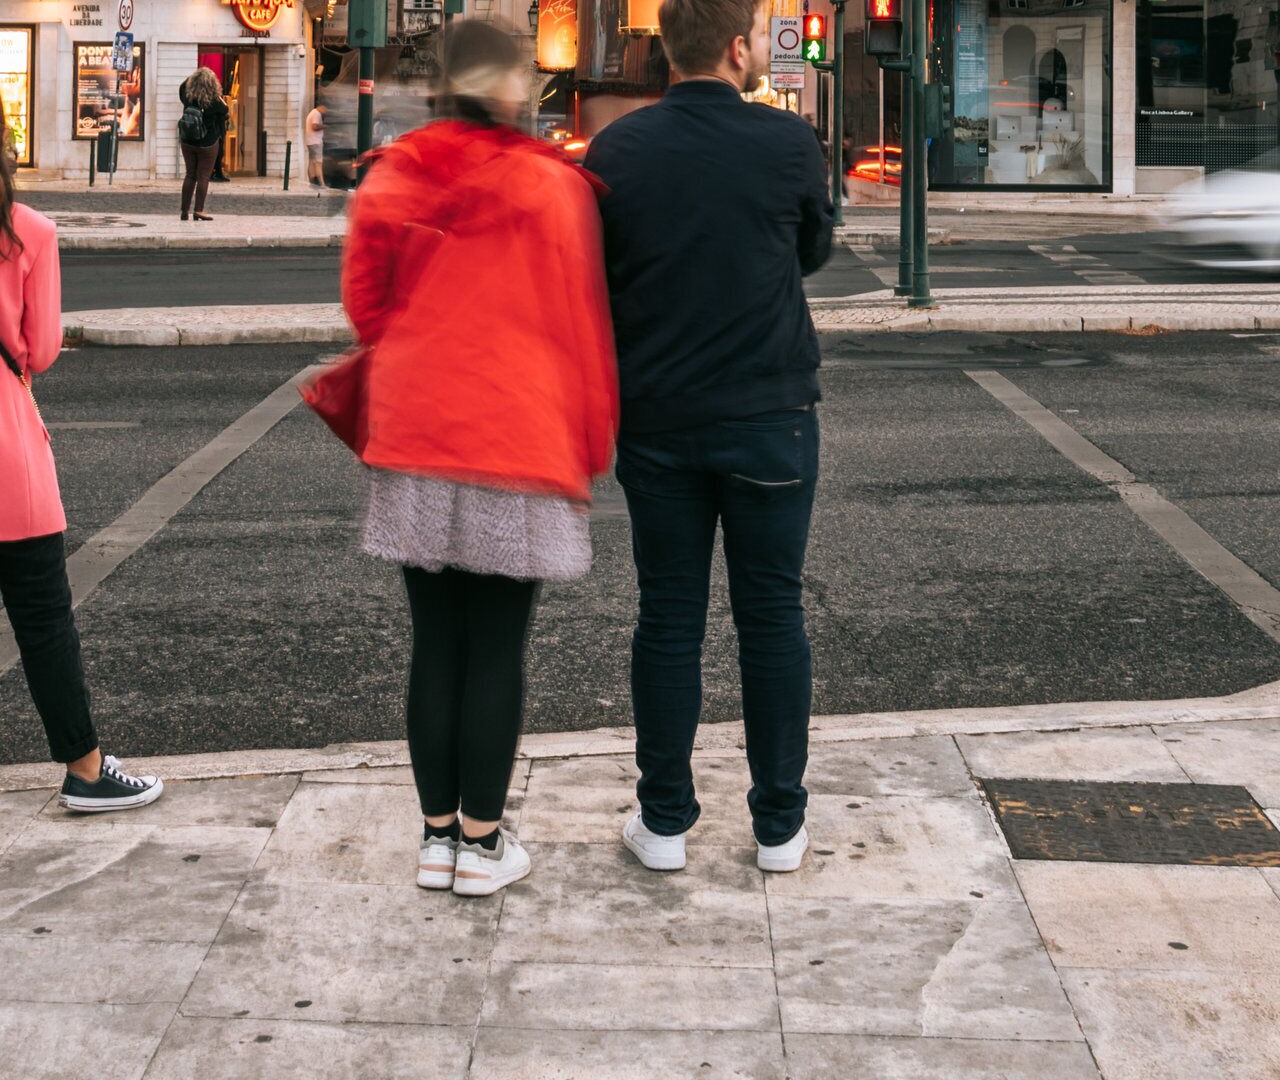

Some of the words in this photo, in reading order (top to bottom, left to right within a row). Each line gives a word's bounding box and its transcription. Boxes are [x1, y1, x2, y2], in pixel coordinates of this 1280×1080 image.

[121, 5, 131, 20] 30
[250, 9, 271, 19] CAFE
[78, 46, 114, 56] DON'T
[79, 57, 87, 65] A
